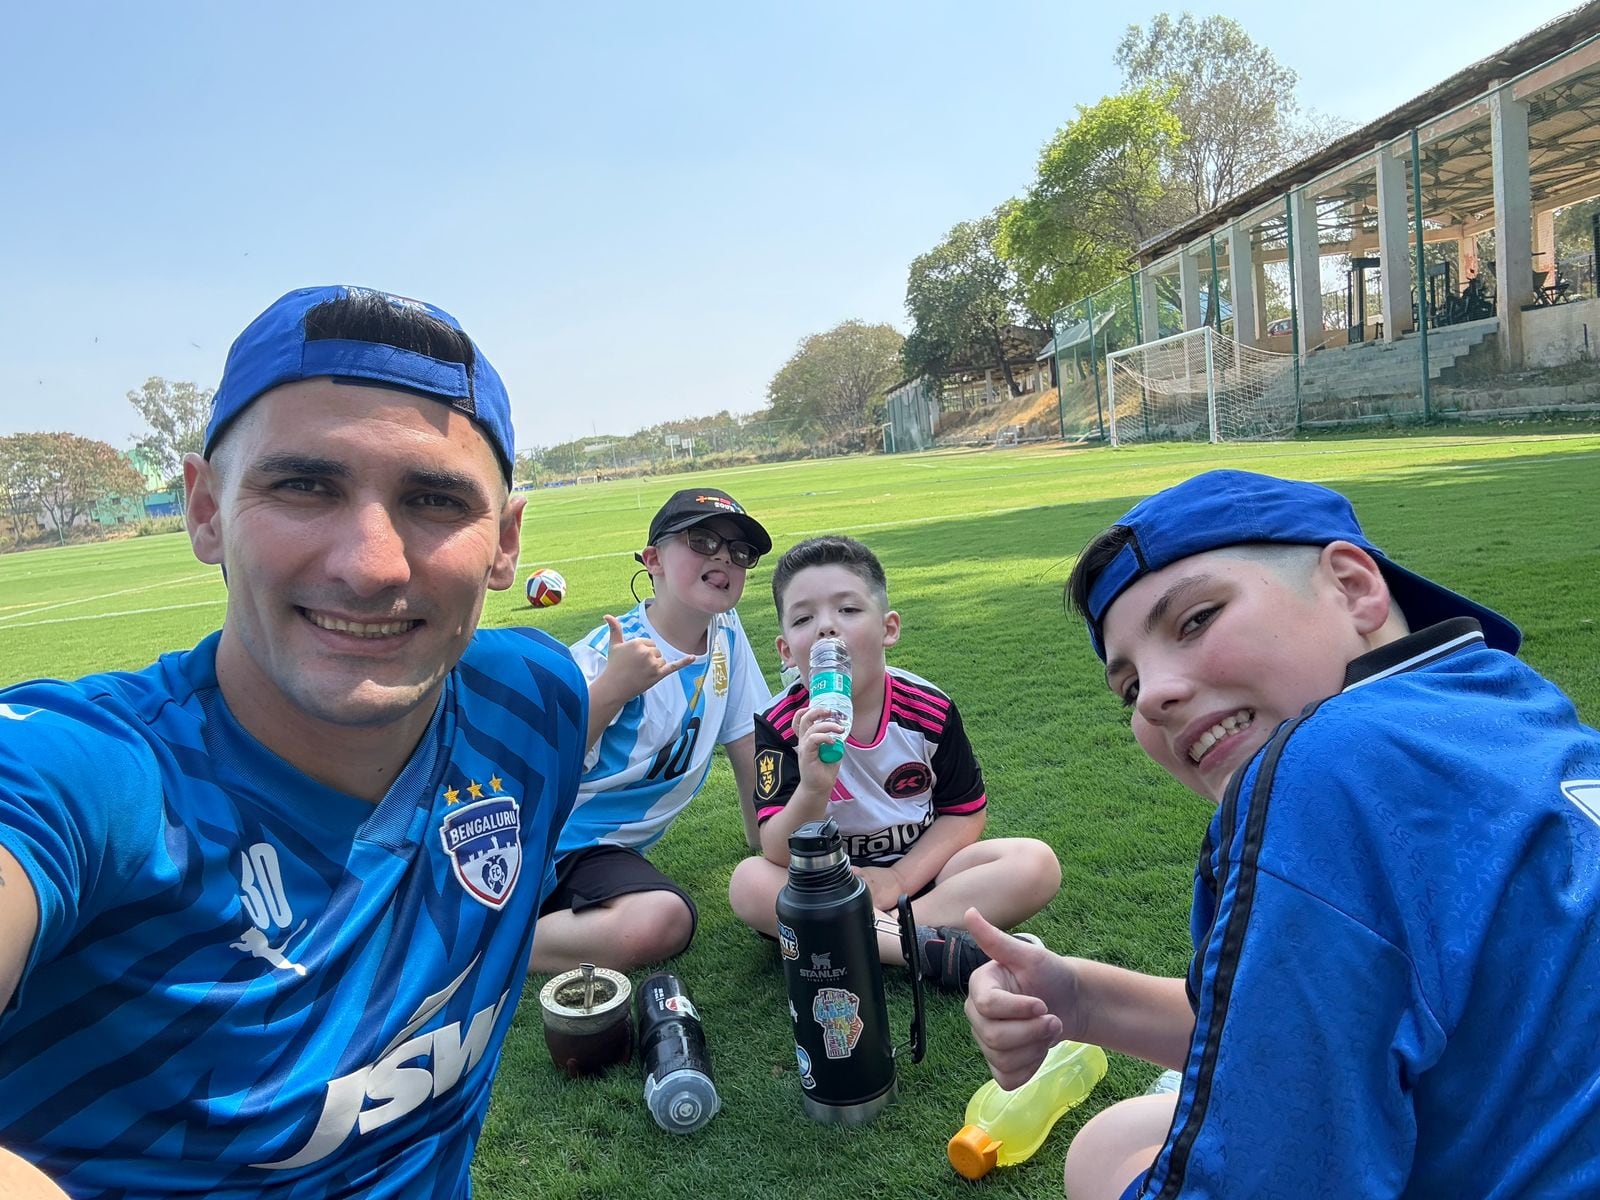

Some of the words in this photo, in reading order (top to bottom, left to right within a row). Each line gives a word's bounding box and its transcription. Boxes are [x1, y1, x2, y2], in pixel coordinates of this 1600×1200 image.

[646, 716, 701, 780] 10
[450, 810, 517, 845] BENGALURU
[240, 842, 293, 930] 30
[491, 867, 501, 879] FC
[800, 966, 847, 978] STANLEY
[248, 987, 511, 1170] JSW
